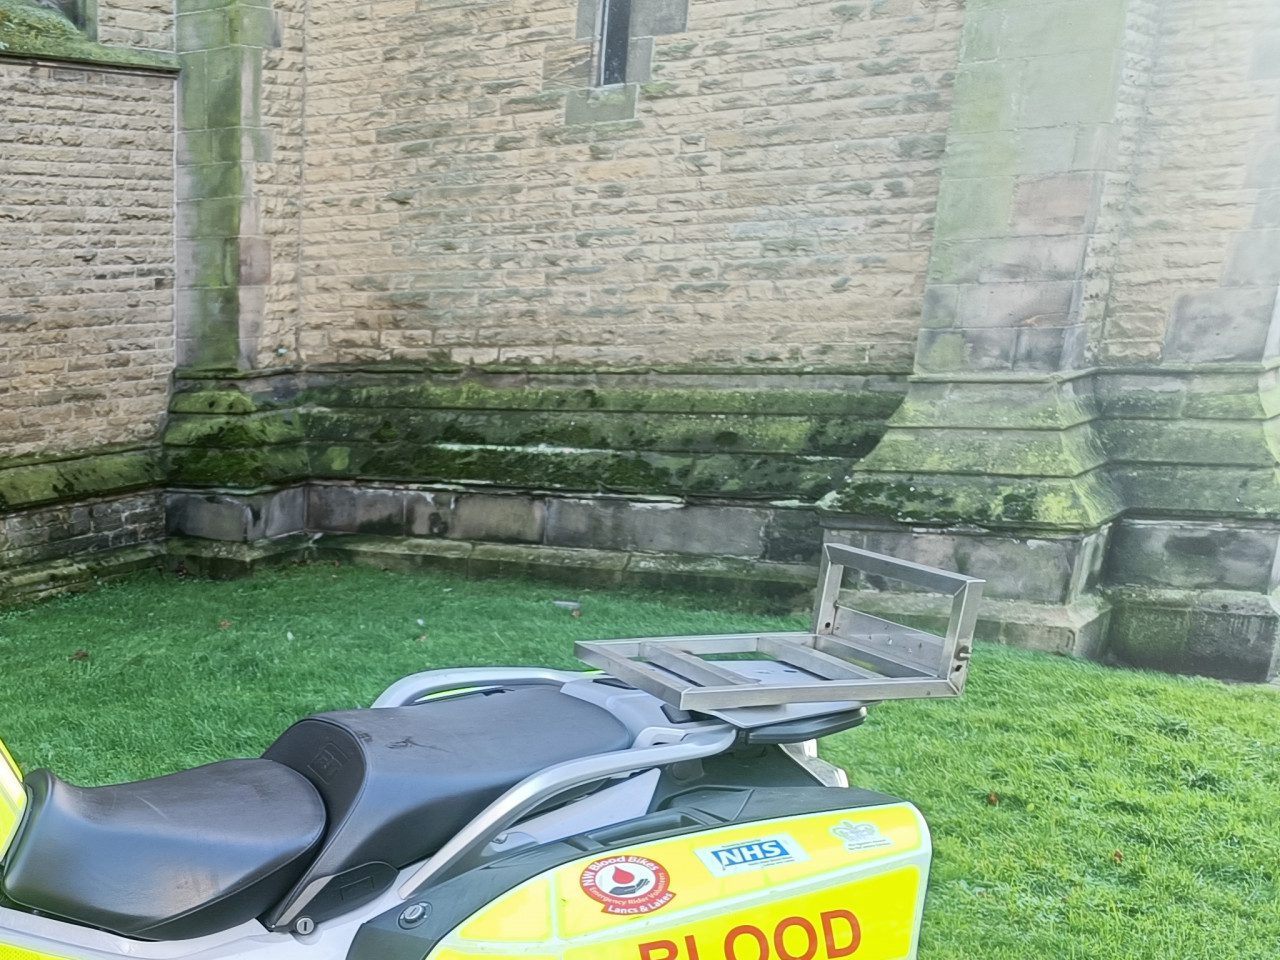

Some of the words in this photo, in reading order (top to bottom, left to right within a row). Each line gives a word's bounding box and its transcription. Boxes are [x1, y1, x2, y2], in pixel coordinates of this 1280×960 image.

[718, 842, 782, 866] NHS
[588, 855, 626, 872] Blood
[627, 856, 659, 871] Bikes
[582, 870, 595, 887] NW
[589, 886, 627, 906] Emergency
[628, 897, 649, 905] Rider
[608, 905, 639, 914] Lancs
[639, 905, 648, 913] &
[647, 892, 673, 911] Lakes
